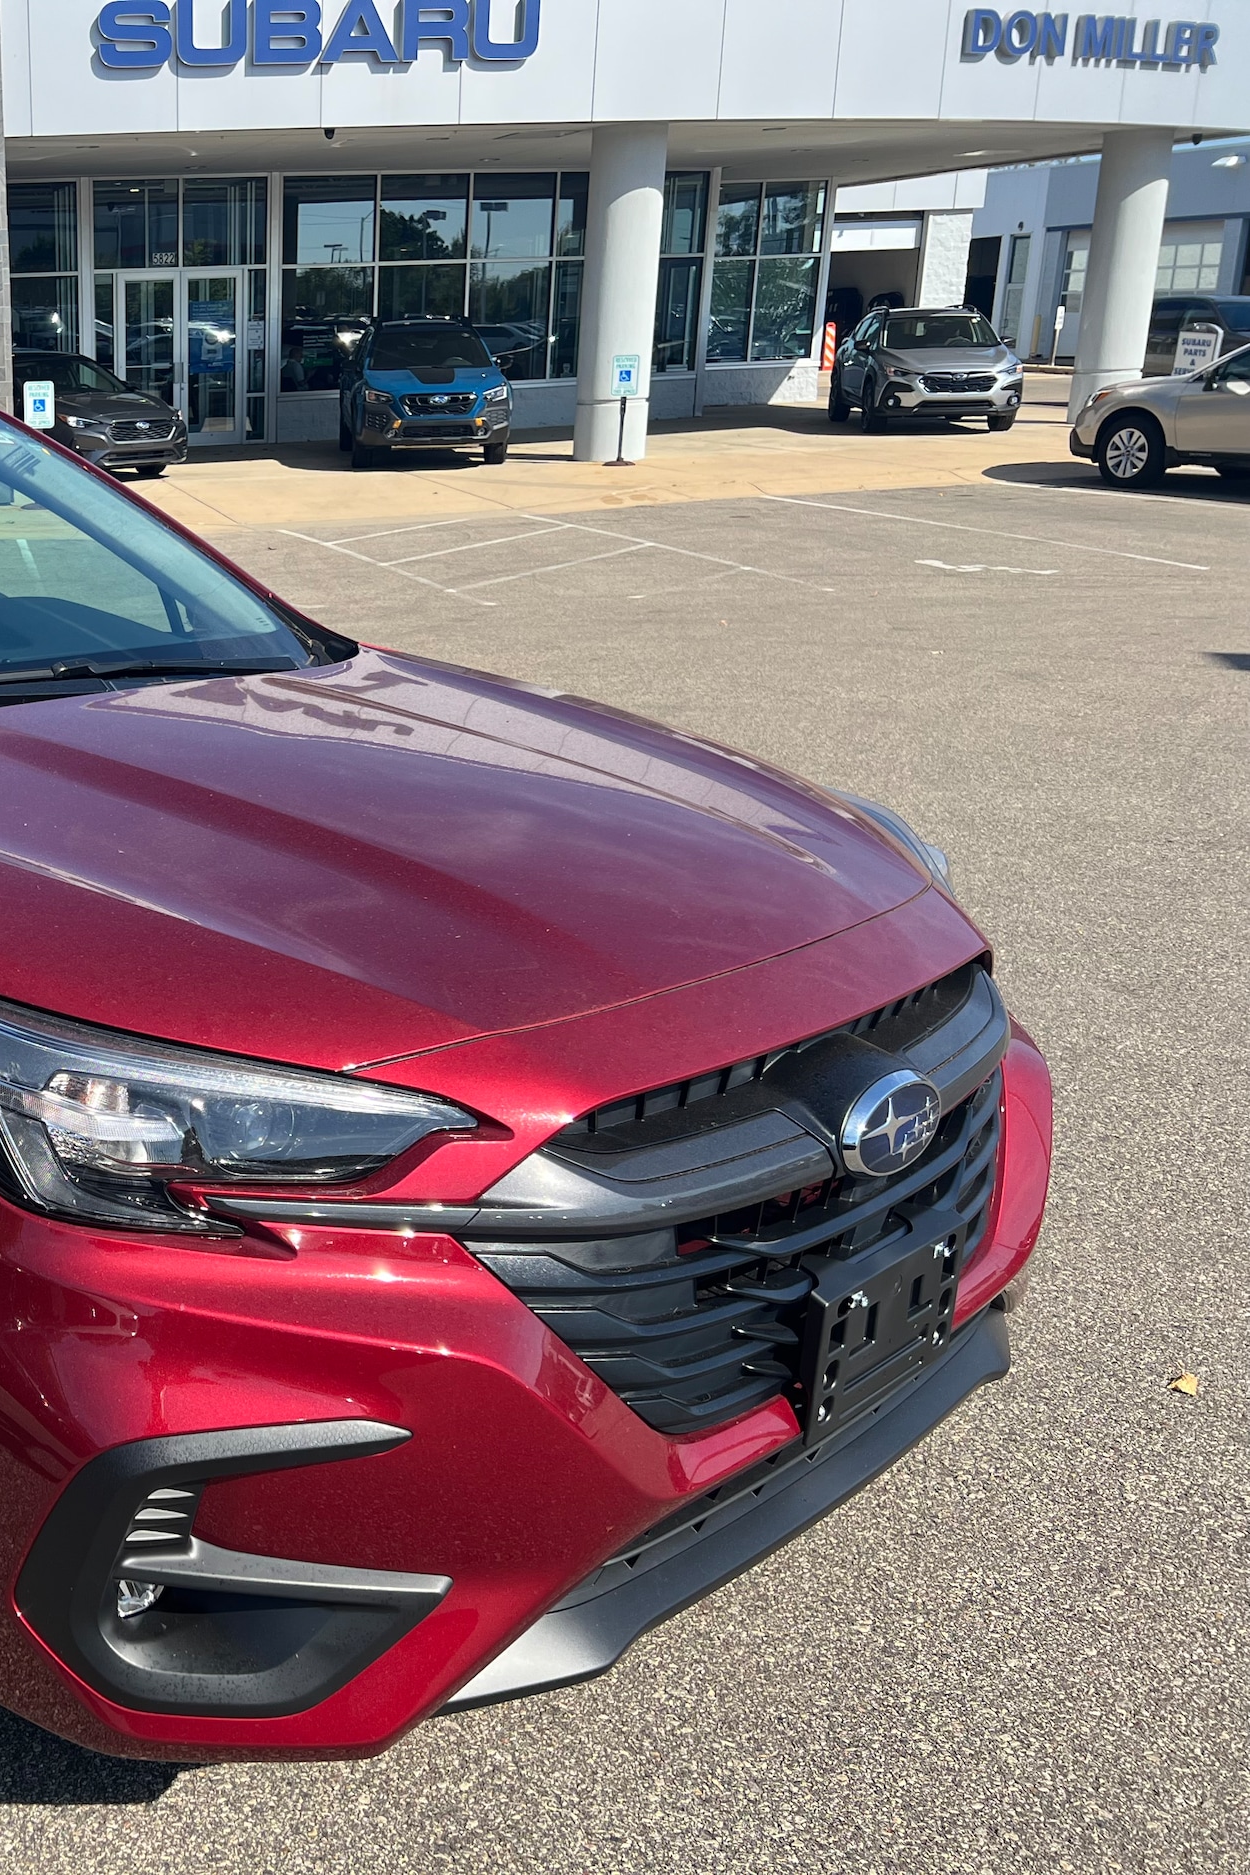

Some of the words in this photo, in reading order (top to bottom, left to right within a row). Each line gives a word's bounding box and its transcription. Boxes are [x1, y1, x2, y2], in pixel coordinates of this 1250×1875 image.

[96, 0, 540, 68] SUBARU
[963, 9, 1069, 57] DON
[1075, 14, 1220, 65] MILLER
[152, 252, 175, 266] 5822
[1181, 338, 1211, 347] SUBARU
[1183, 348, 1207, 357] PARTS
